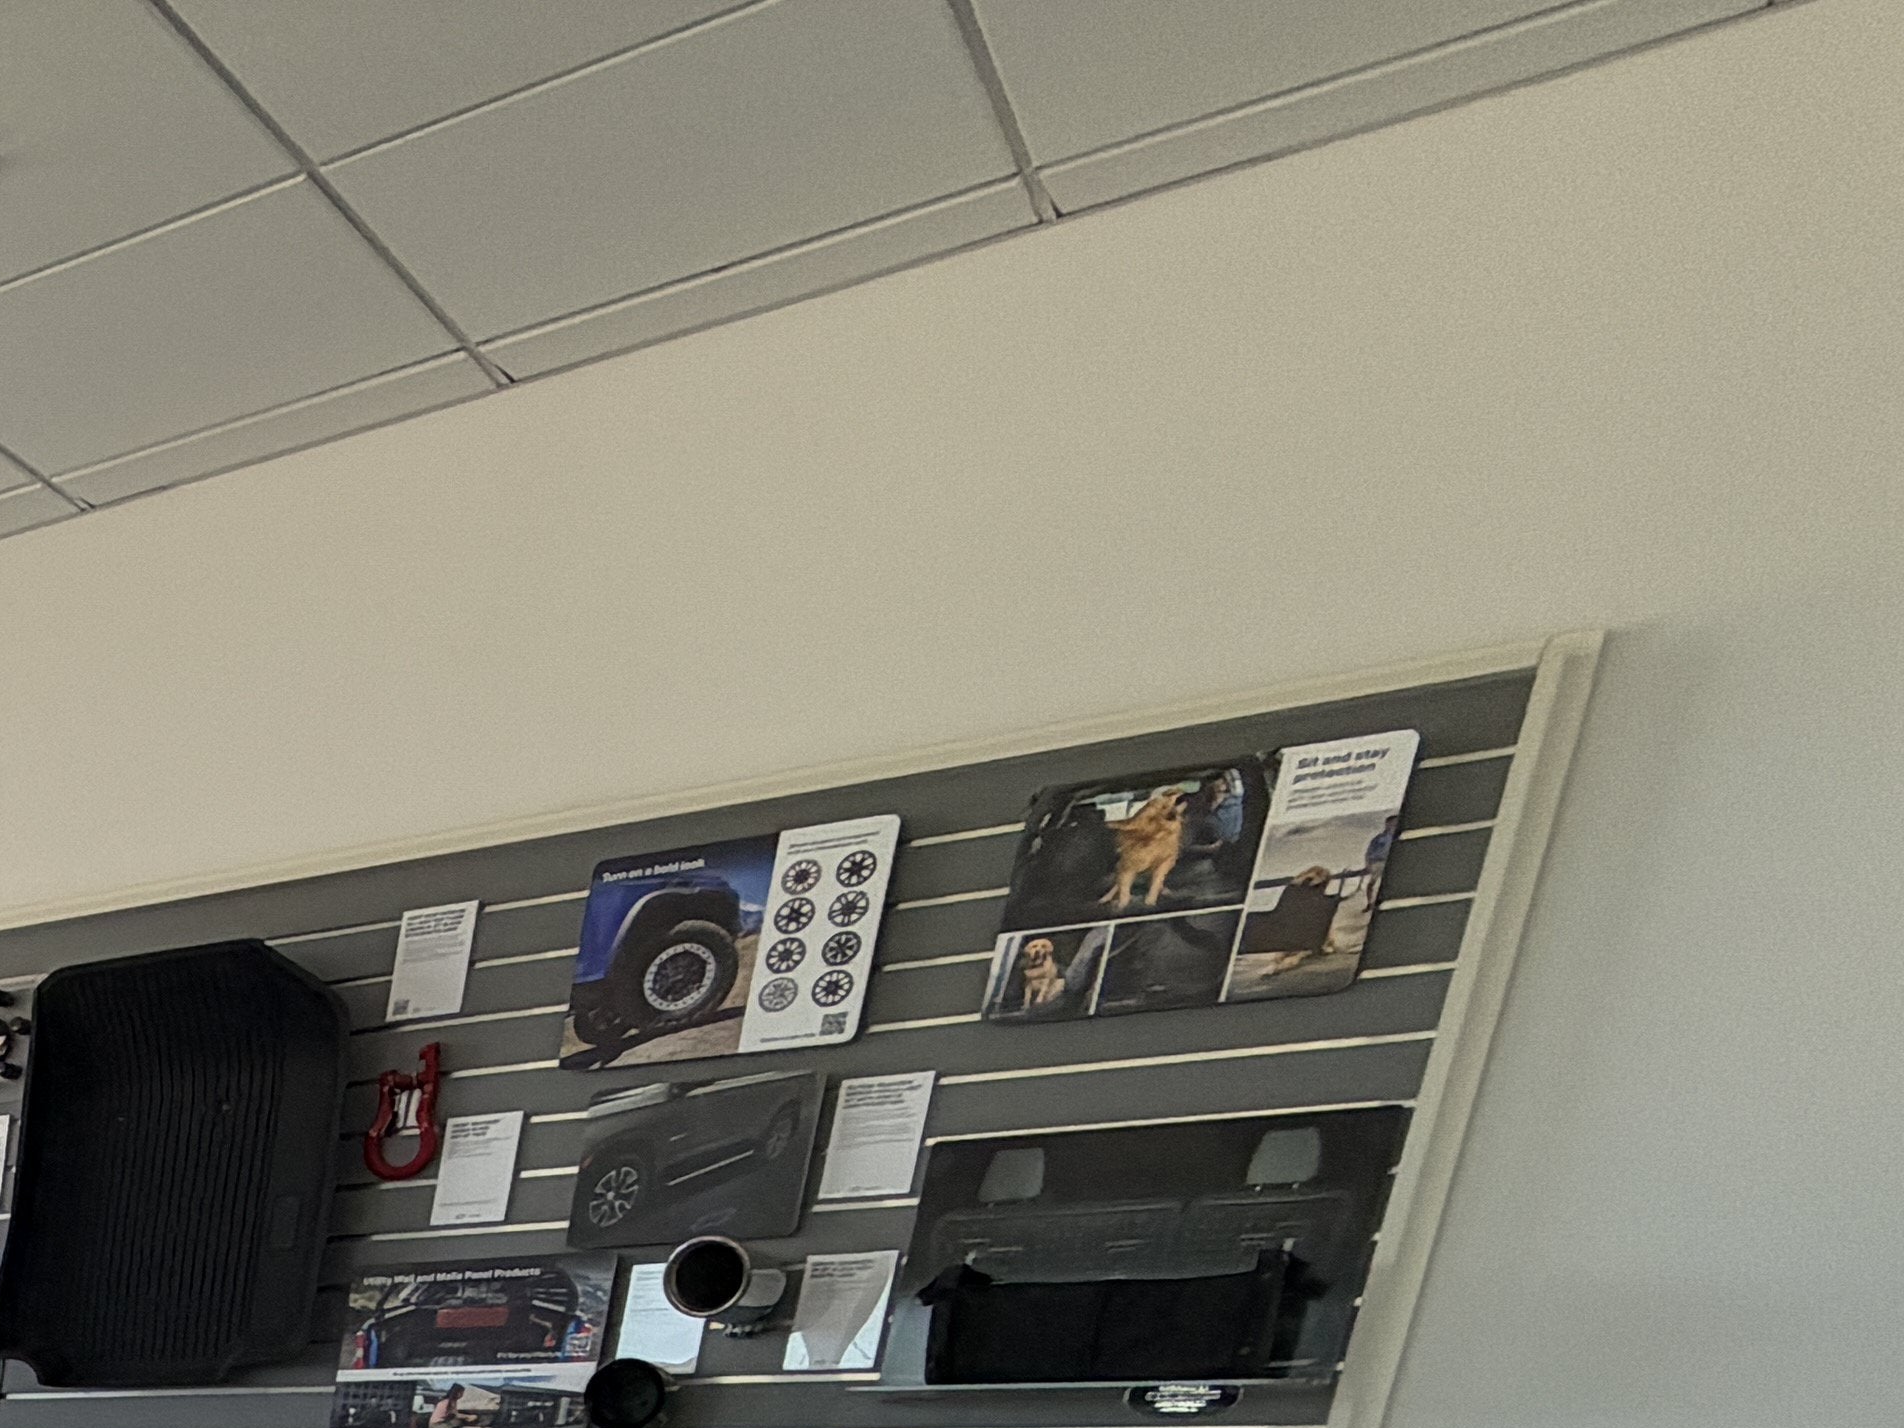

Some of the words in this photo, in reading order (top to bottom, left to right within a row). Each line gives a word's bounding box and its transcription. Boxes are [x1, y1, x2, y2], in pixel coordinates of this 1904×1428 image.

[1322, 751, 1352, 766] and
[1355, 746, 1391, 760] stay
[494, 1267, 542, 1278] Products
